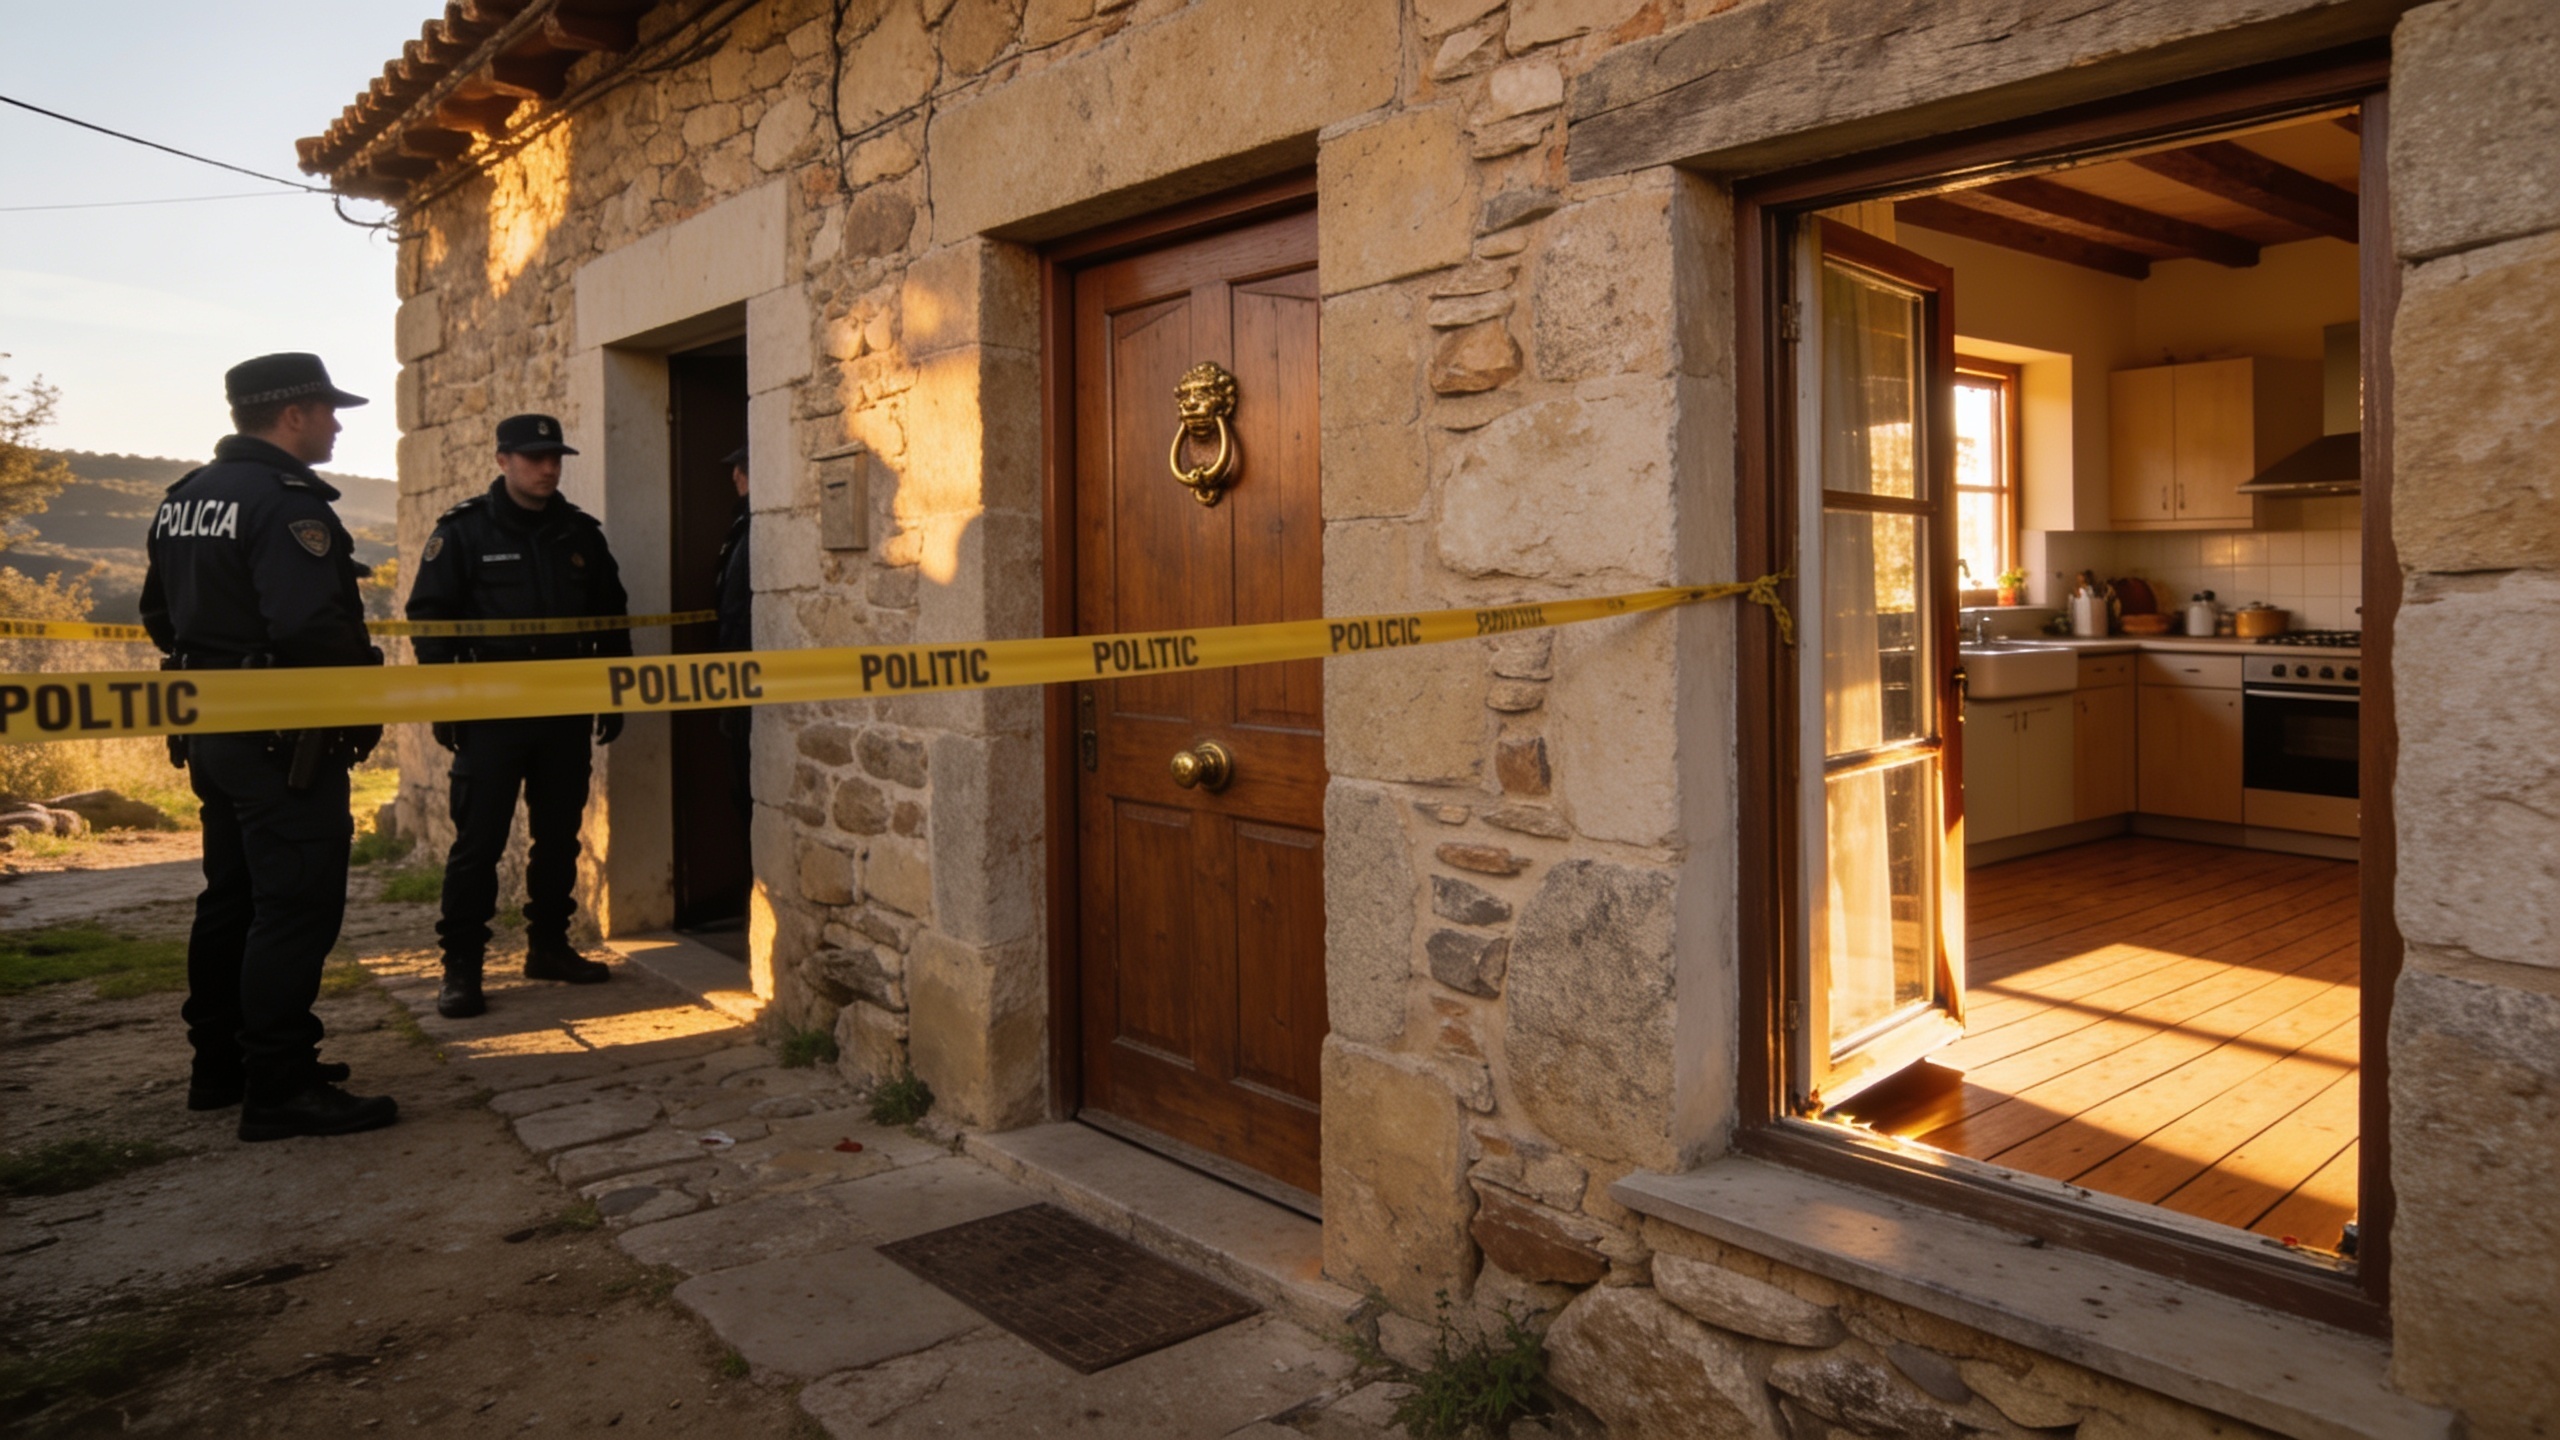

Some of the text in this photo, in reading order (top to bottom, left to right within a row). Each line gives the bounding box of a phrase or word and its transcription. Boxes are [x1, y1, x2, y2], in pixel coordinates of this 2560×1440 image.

[156, 500, 239, 540] POLICIA
[0, 617, 1421, 733] POLTIC POLICIC POLITIC POLITIC POLICIC
